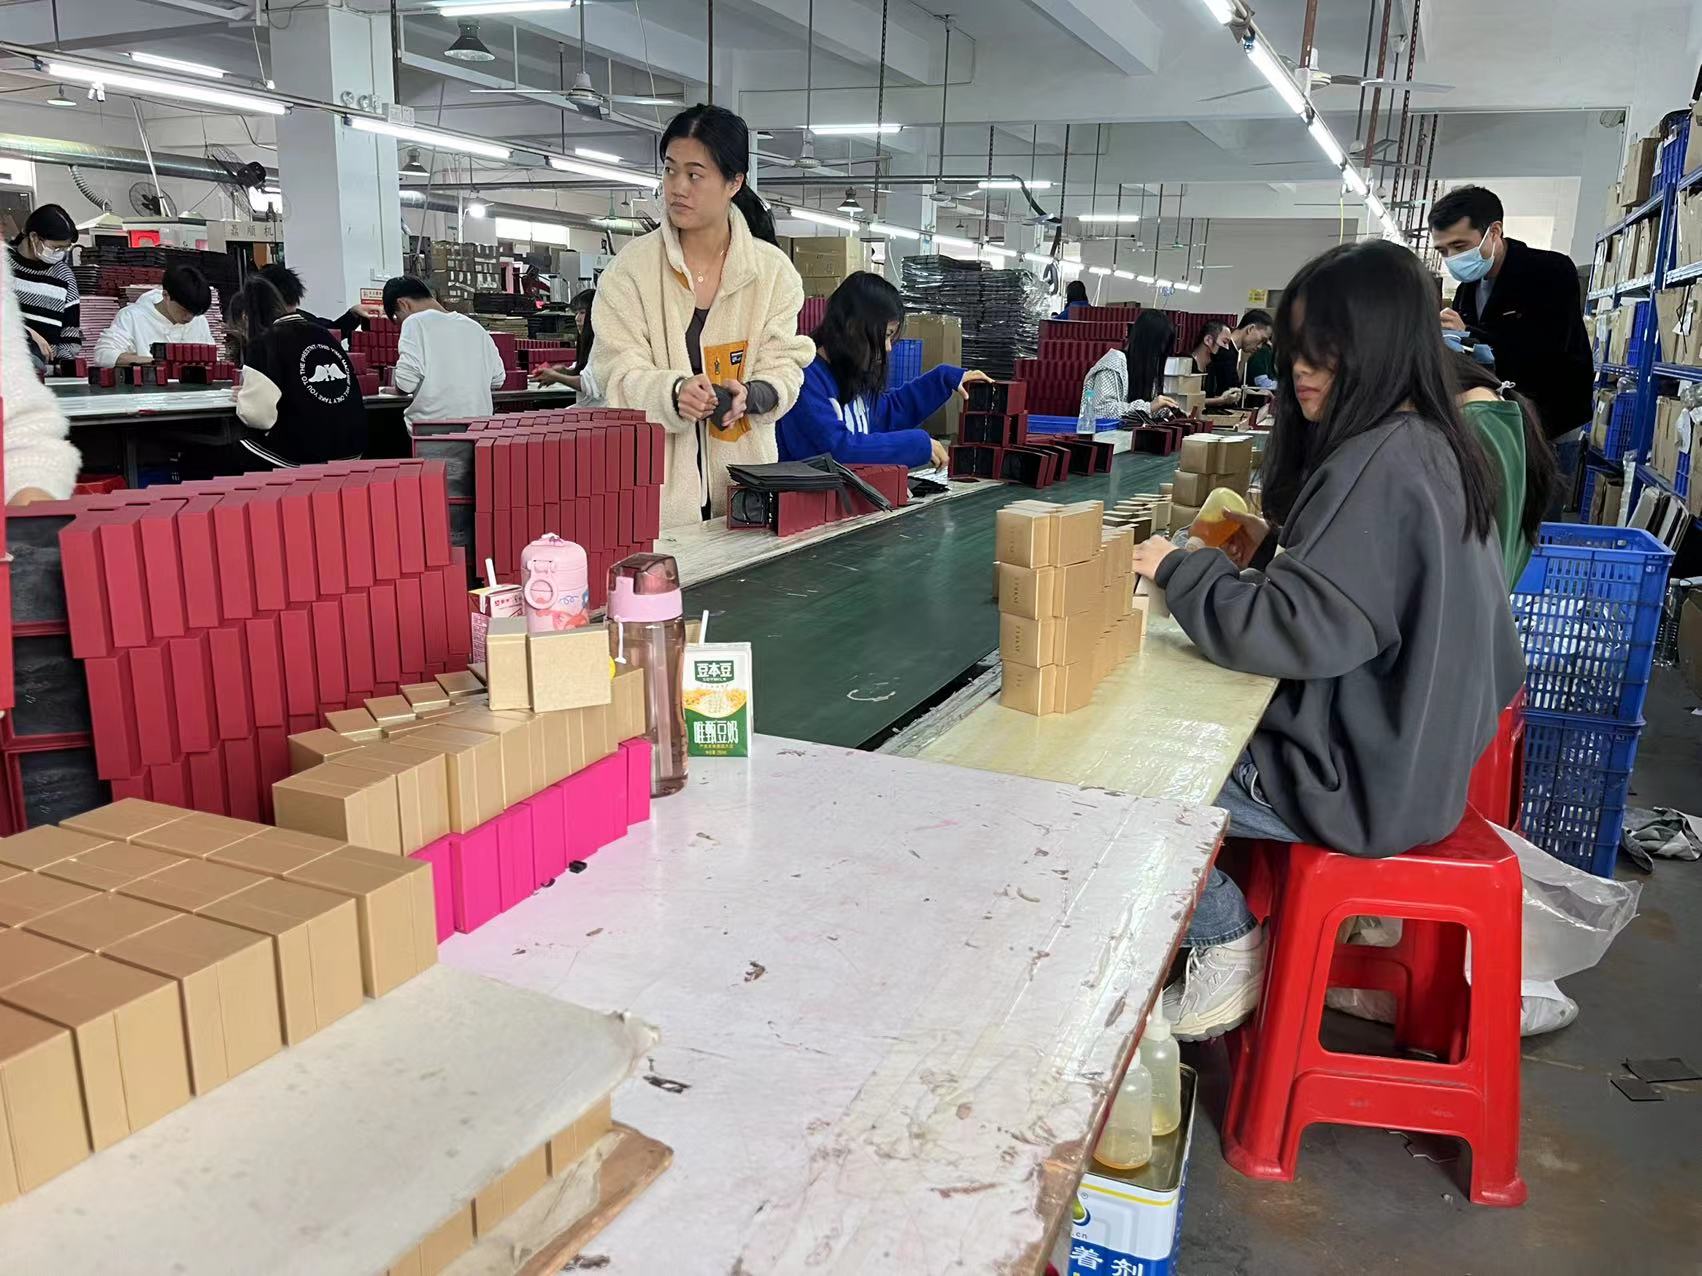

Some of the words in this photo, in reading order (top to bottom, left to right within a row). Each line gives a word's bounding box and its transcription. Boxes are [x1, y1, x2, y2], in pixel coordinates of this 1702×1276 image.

[301, 375, 309, 386] TO
[306, 385, 319, 397] YOU
[696, 662, 733, 678] 豆本豆
[693, 720, 739, 744] 唯甄豆奶
